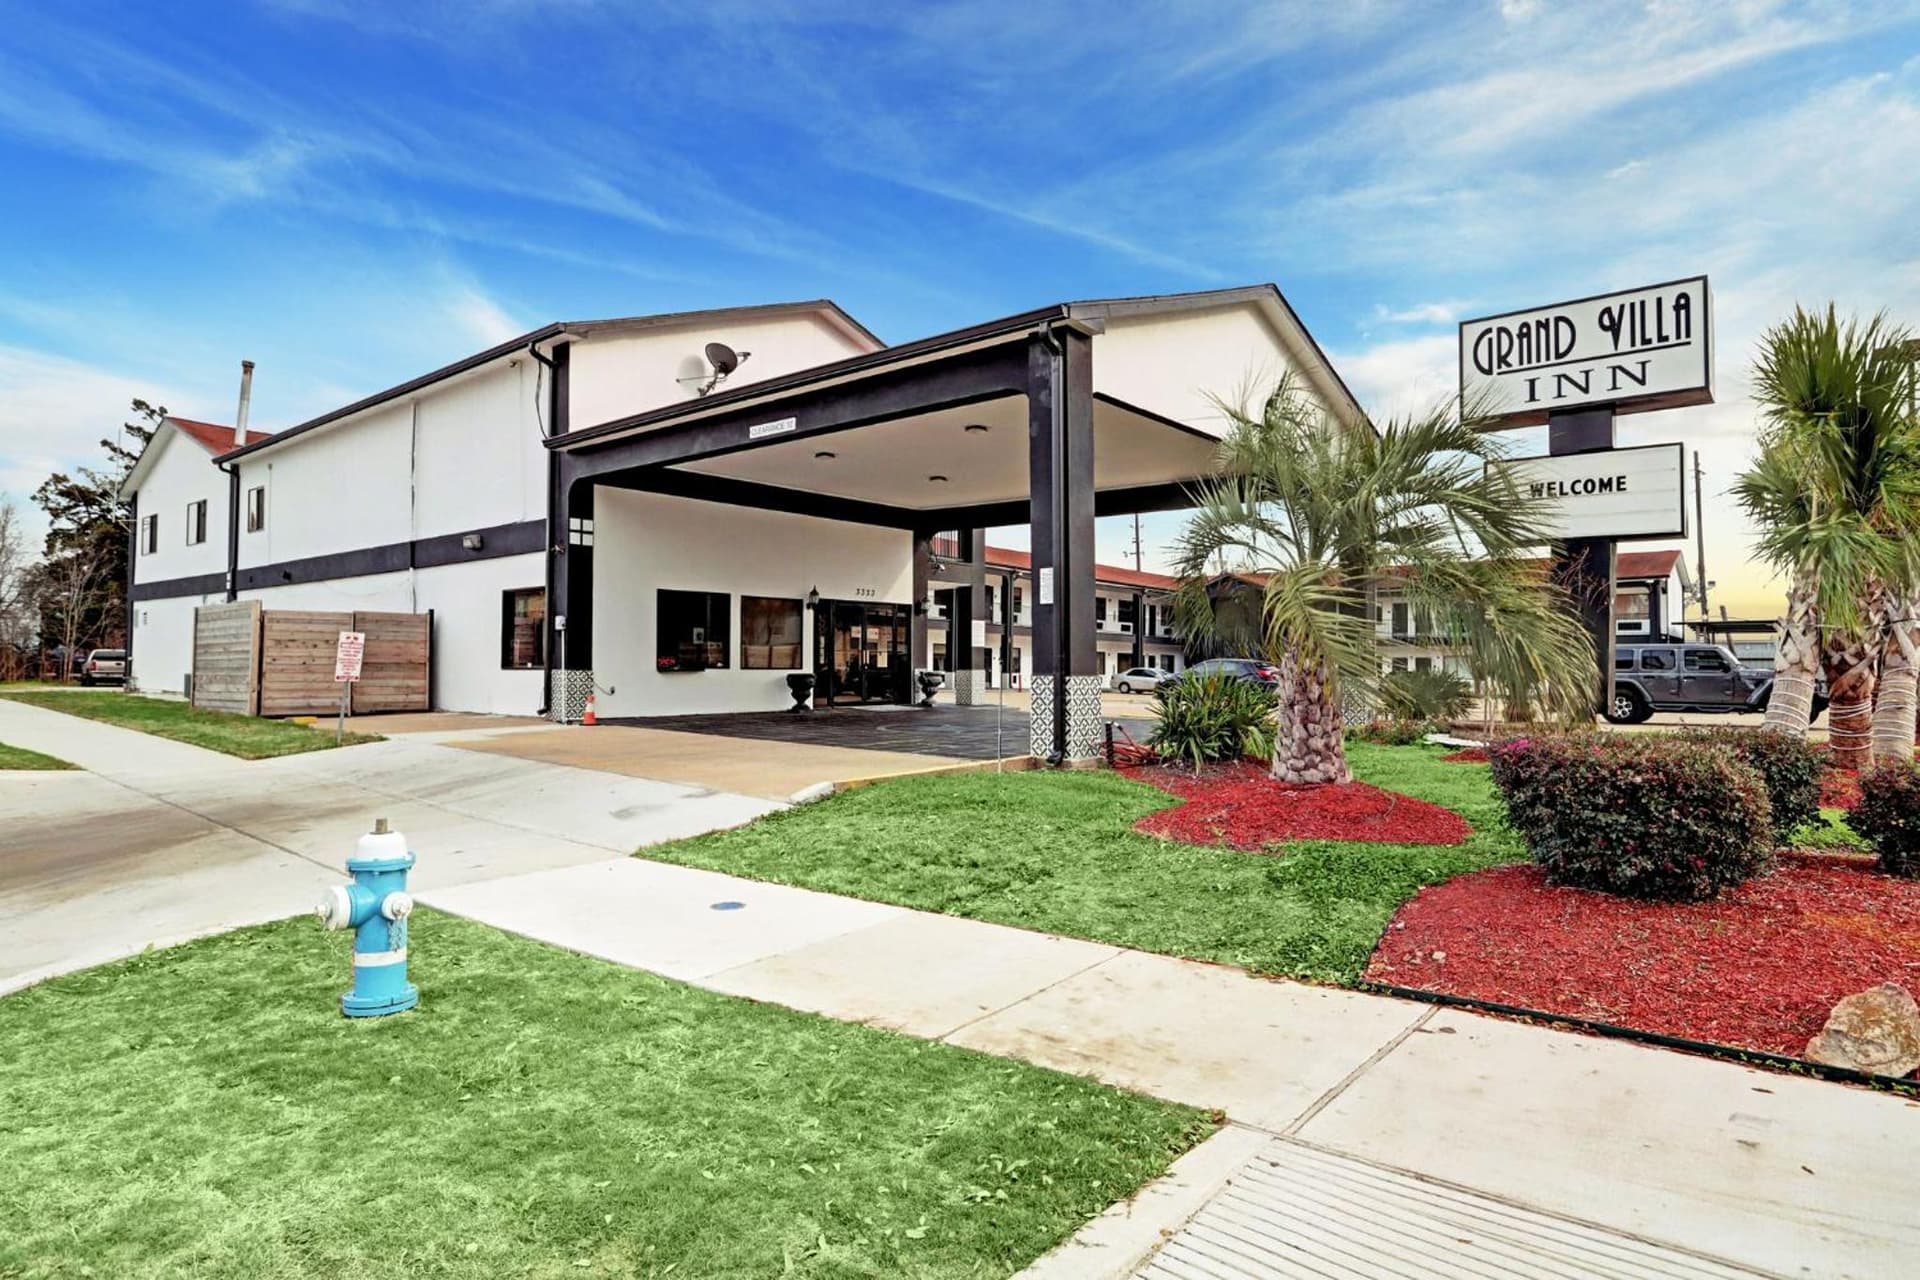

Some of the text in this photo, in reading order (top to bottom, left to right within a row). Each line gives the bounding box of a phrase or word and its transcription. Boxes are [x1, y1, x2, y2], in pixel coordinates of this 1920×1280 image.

[1473, 292, 1691, 375] GRAND VILLA
[1524, 360, 1652, 402] INN
[1530, 475, 1627, 498] WELCOME
